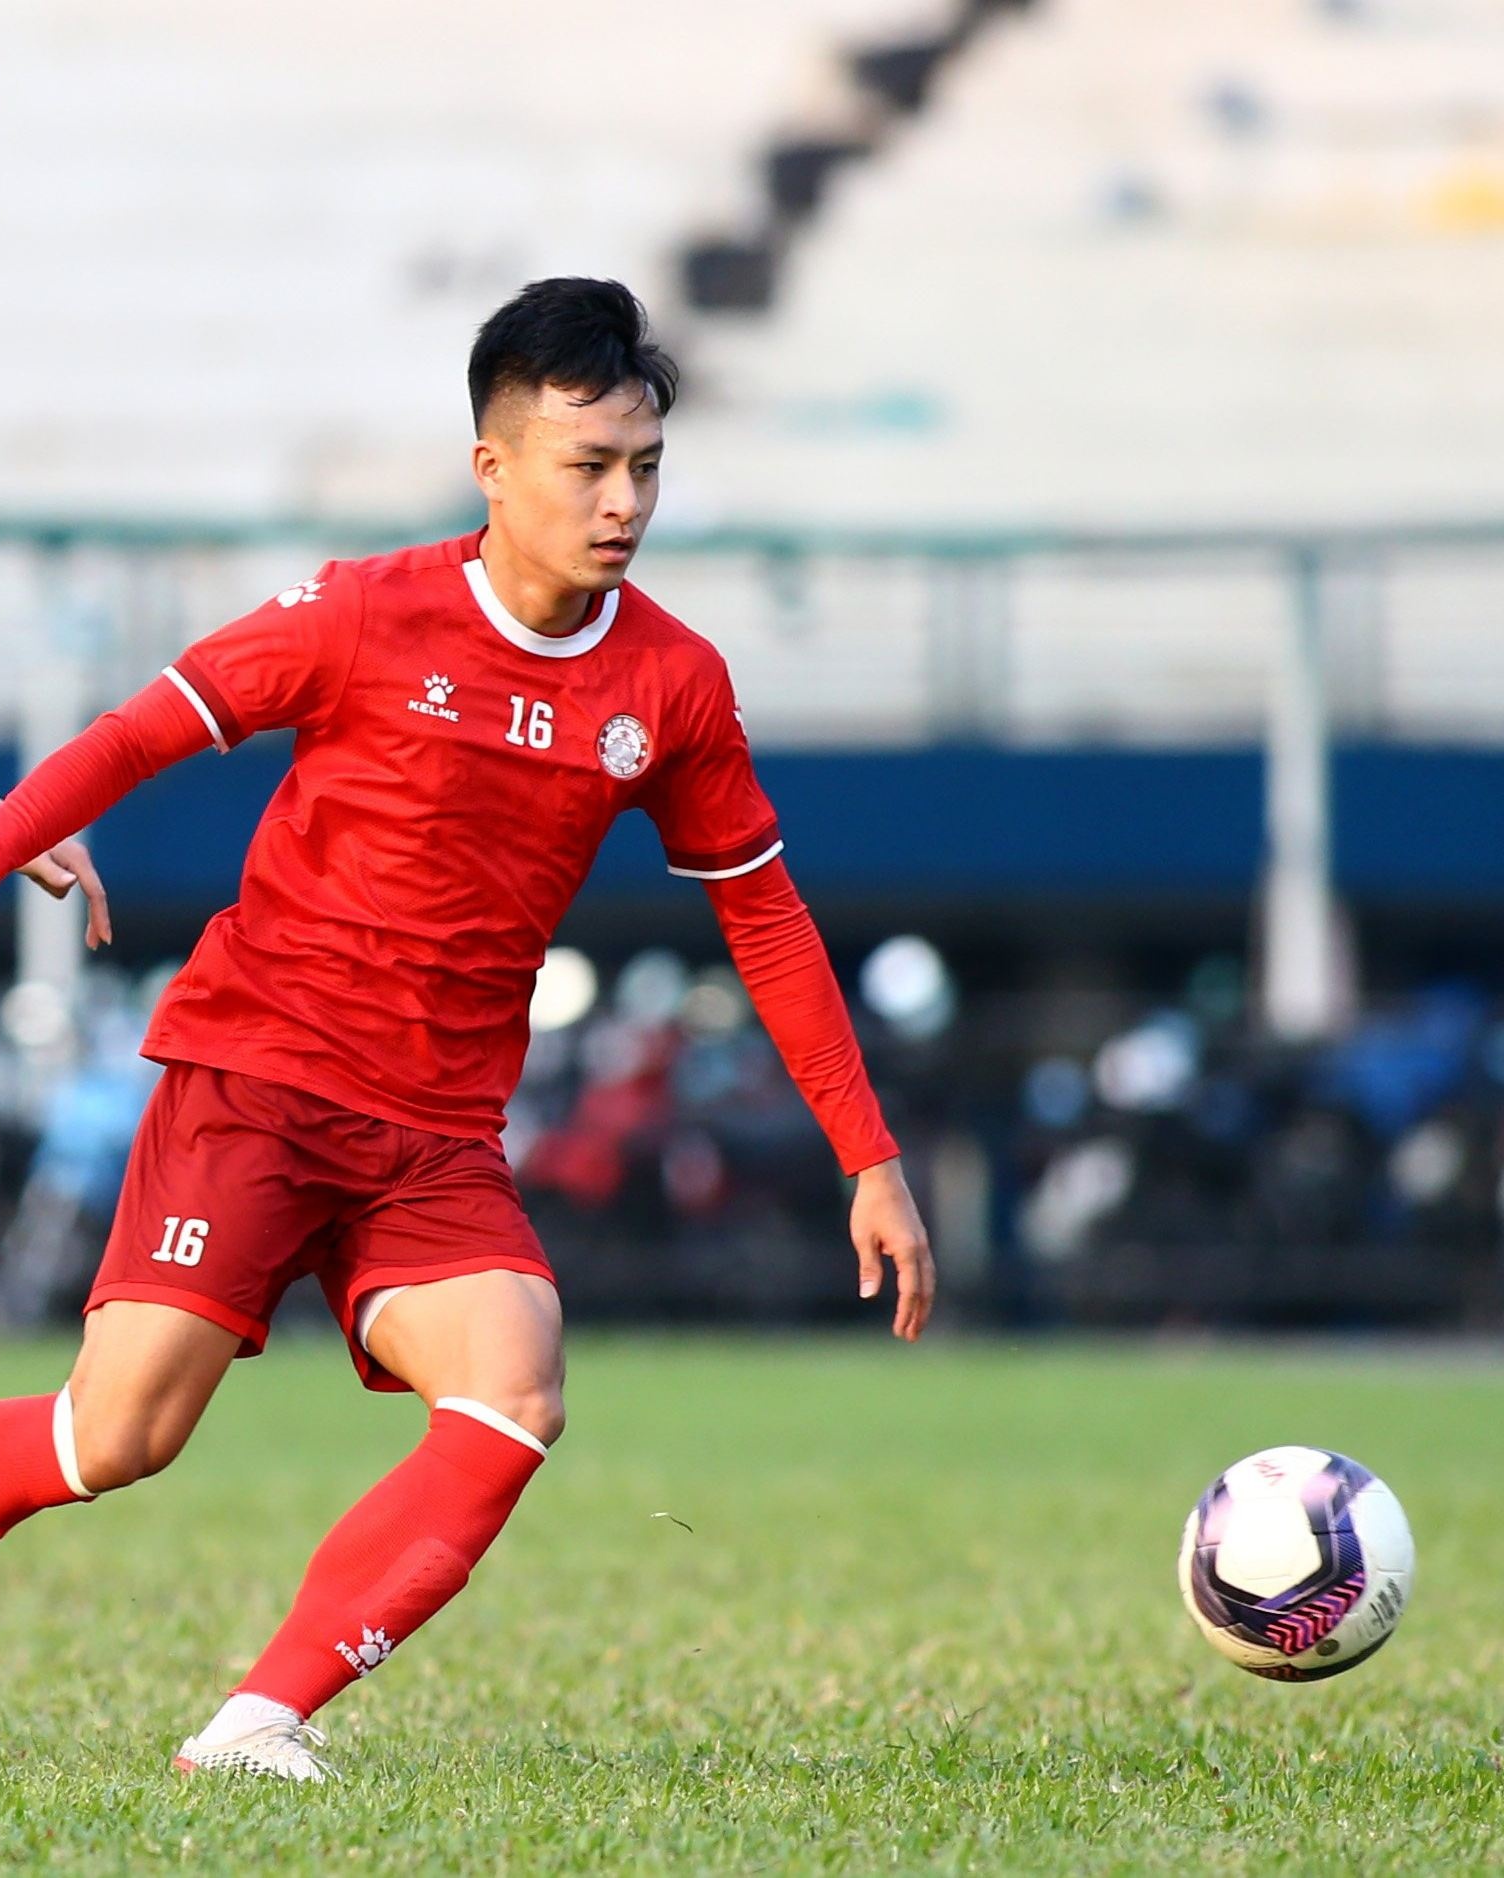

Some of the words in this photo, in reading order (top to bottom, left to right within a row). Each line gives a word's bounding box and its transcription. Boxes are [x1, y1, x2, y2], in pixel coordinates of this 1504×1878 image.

[407, 699, 460, 722] KELME
[504, 694, 554, 750] 16
[150, 1215, 211, 1268] 16
[335, 1640, 371, 1677] KELM
